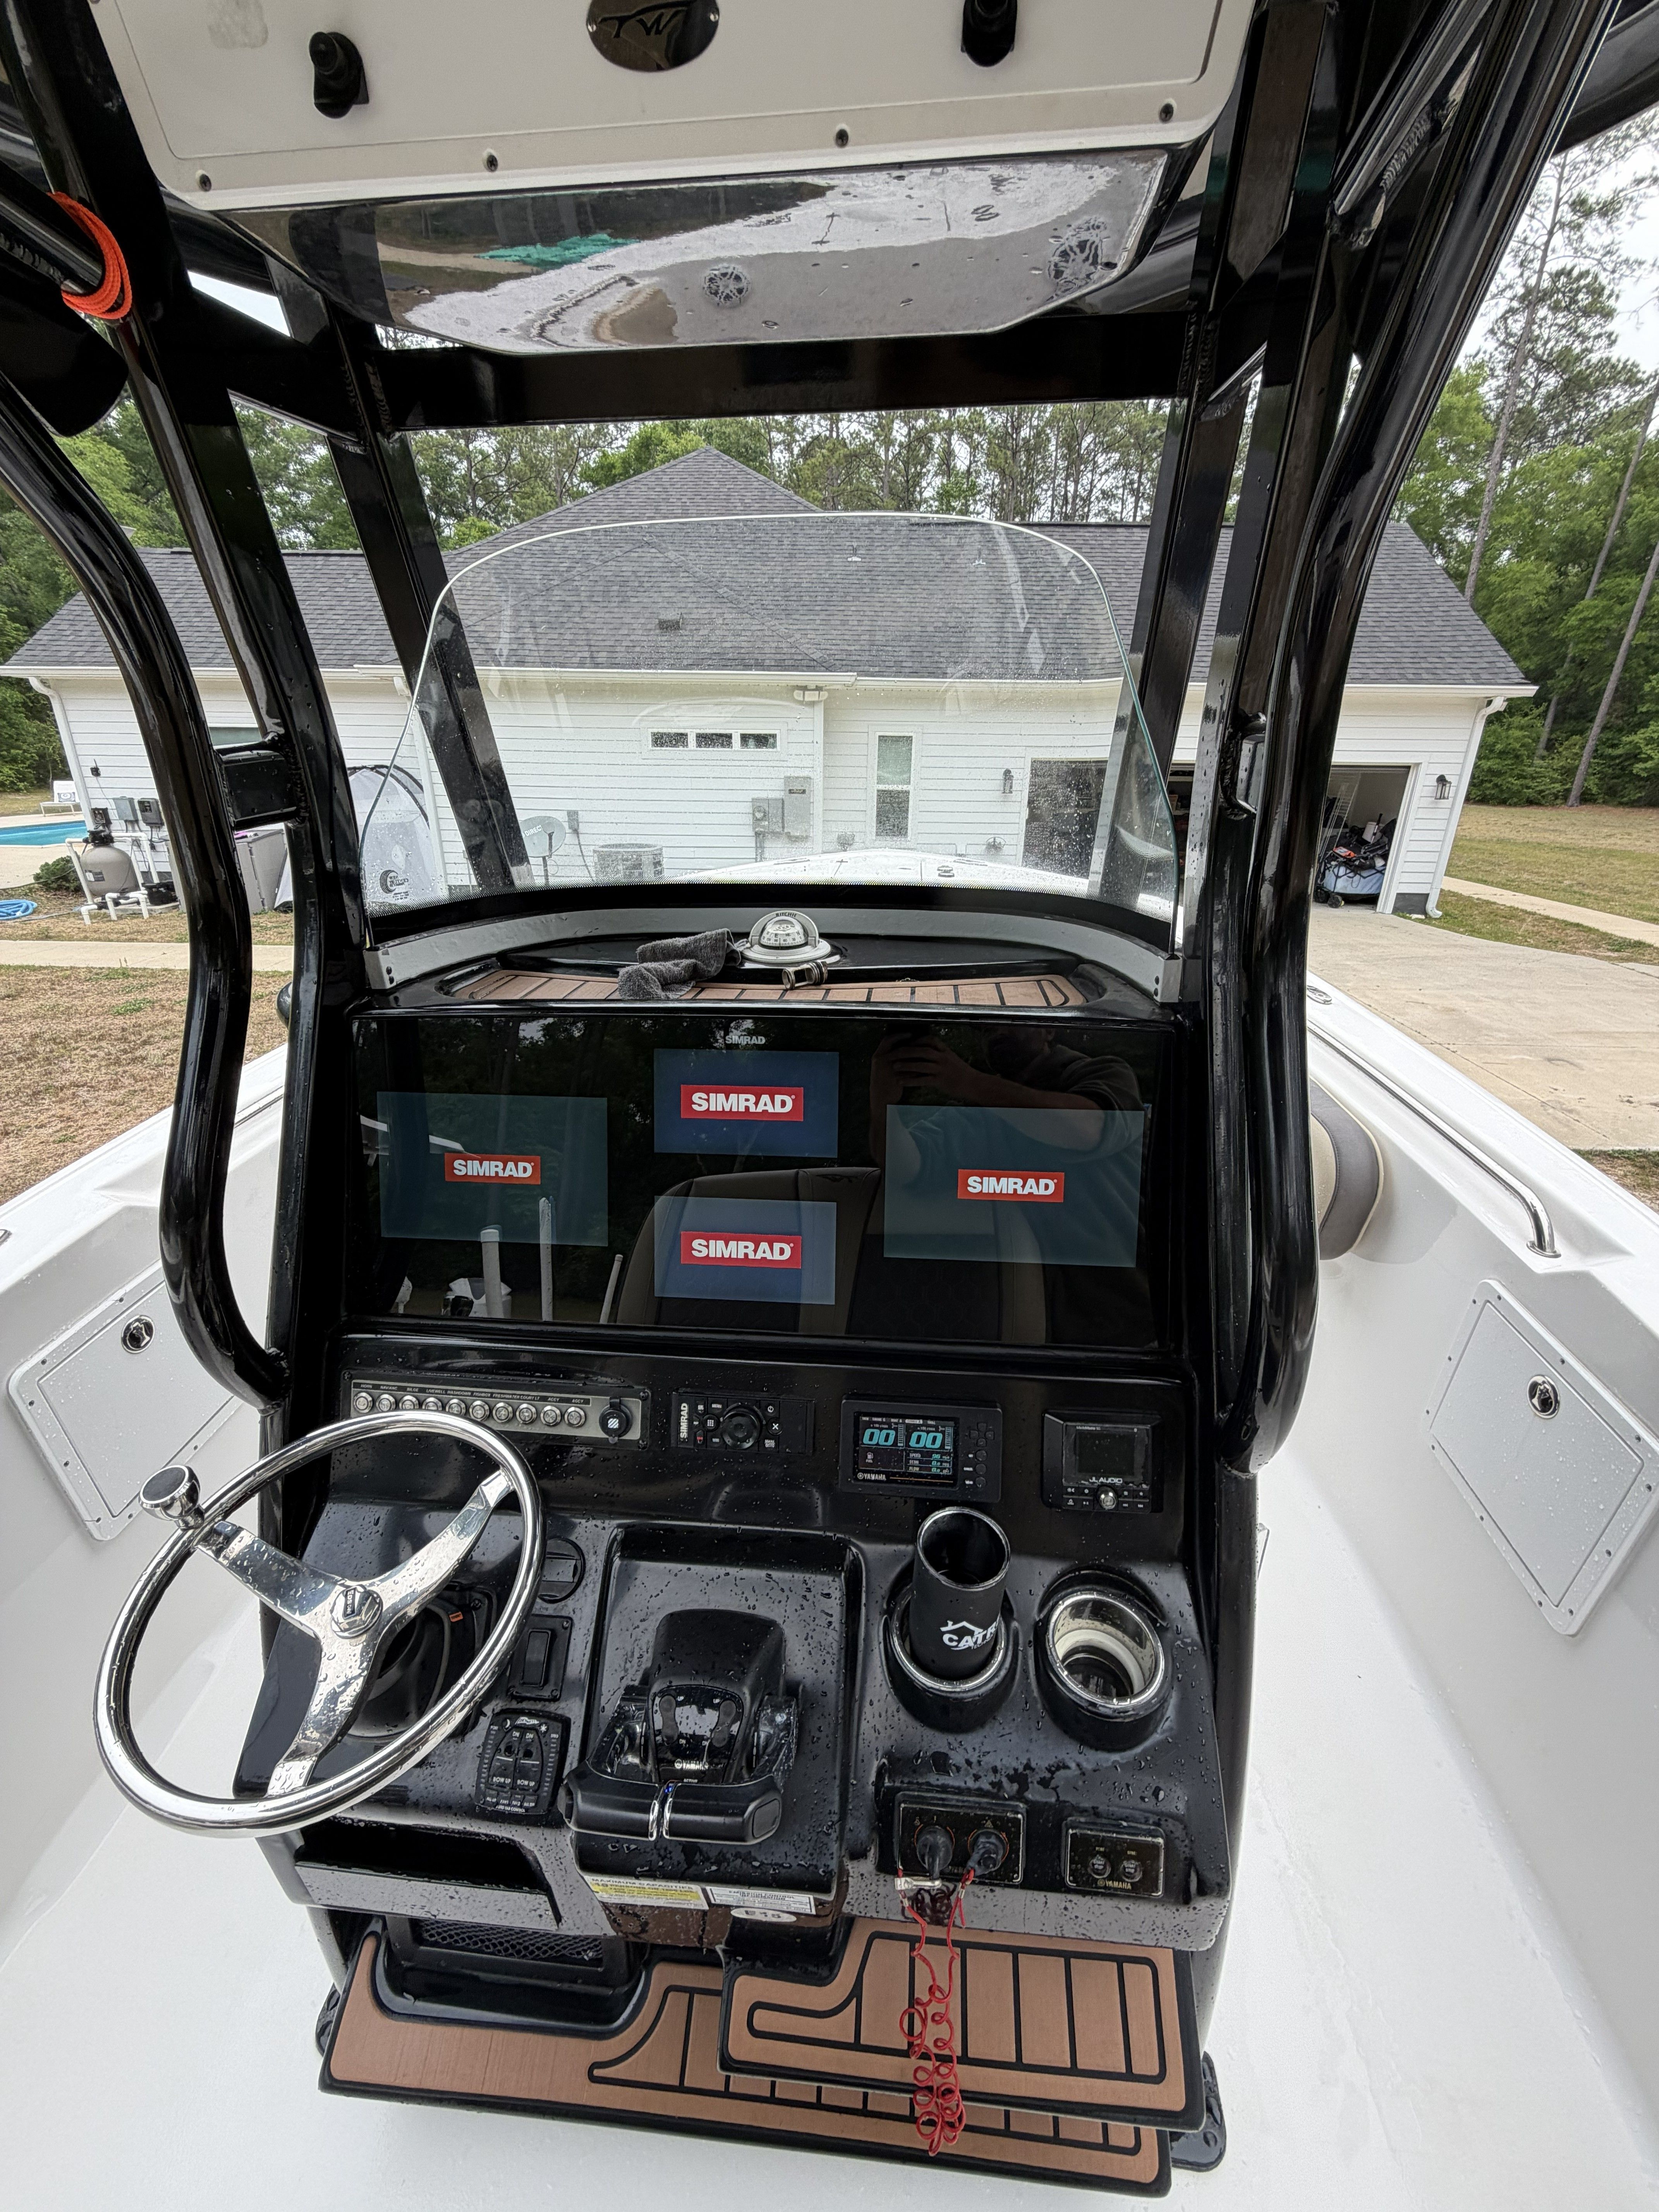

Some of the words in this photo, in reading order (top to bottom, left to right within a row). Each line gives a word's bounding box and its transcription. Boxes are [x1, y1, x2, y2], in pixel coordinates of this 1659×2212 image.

[725, 1035, 766, 1044] SIMRAD
[691, 1092, 793, 1113] SIMRAD
[453, 1159, 532, 1178] SIMRAD
[967, 1176, 1055, 1195] SIMRAD
[691, 1239, 791, 1261] SIMRAD
[680, 1403, 689, 1439] SIMRAD
[1106, 1880, 1132, 1890] YAMAHA
